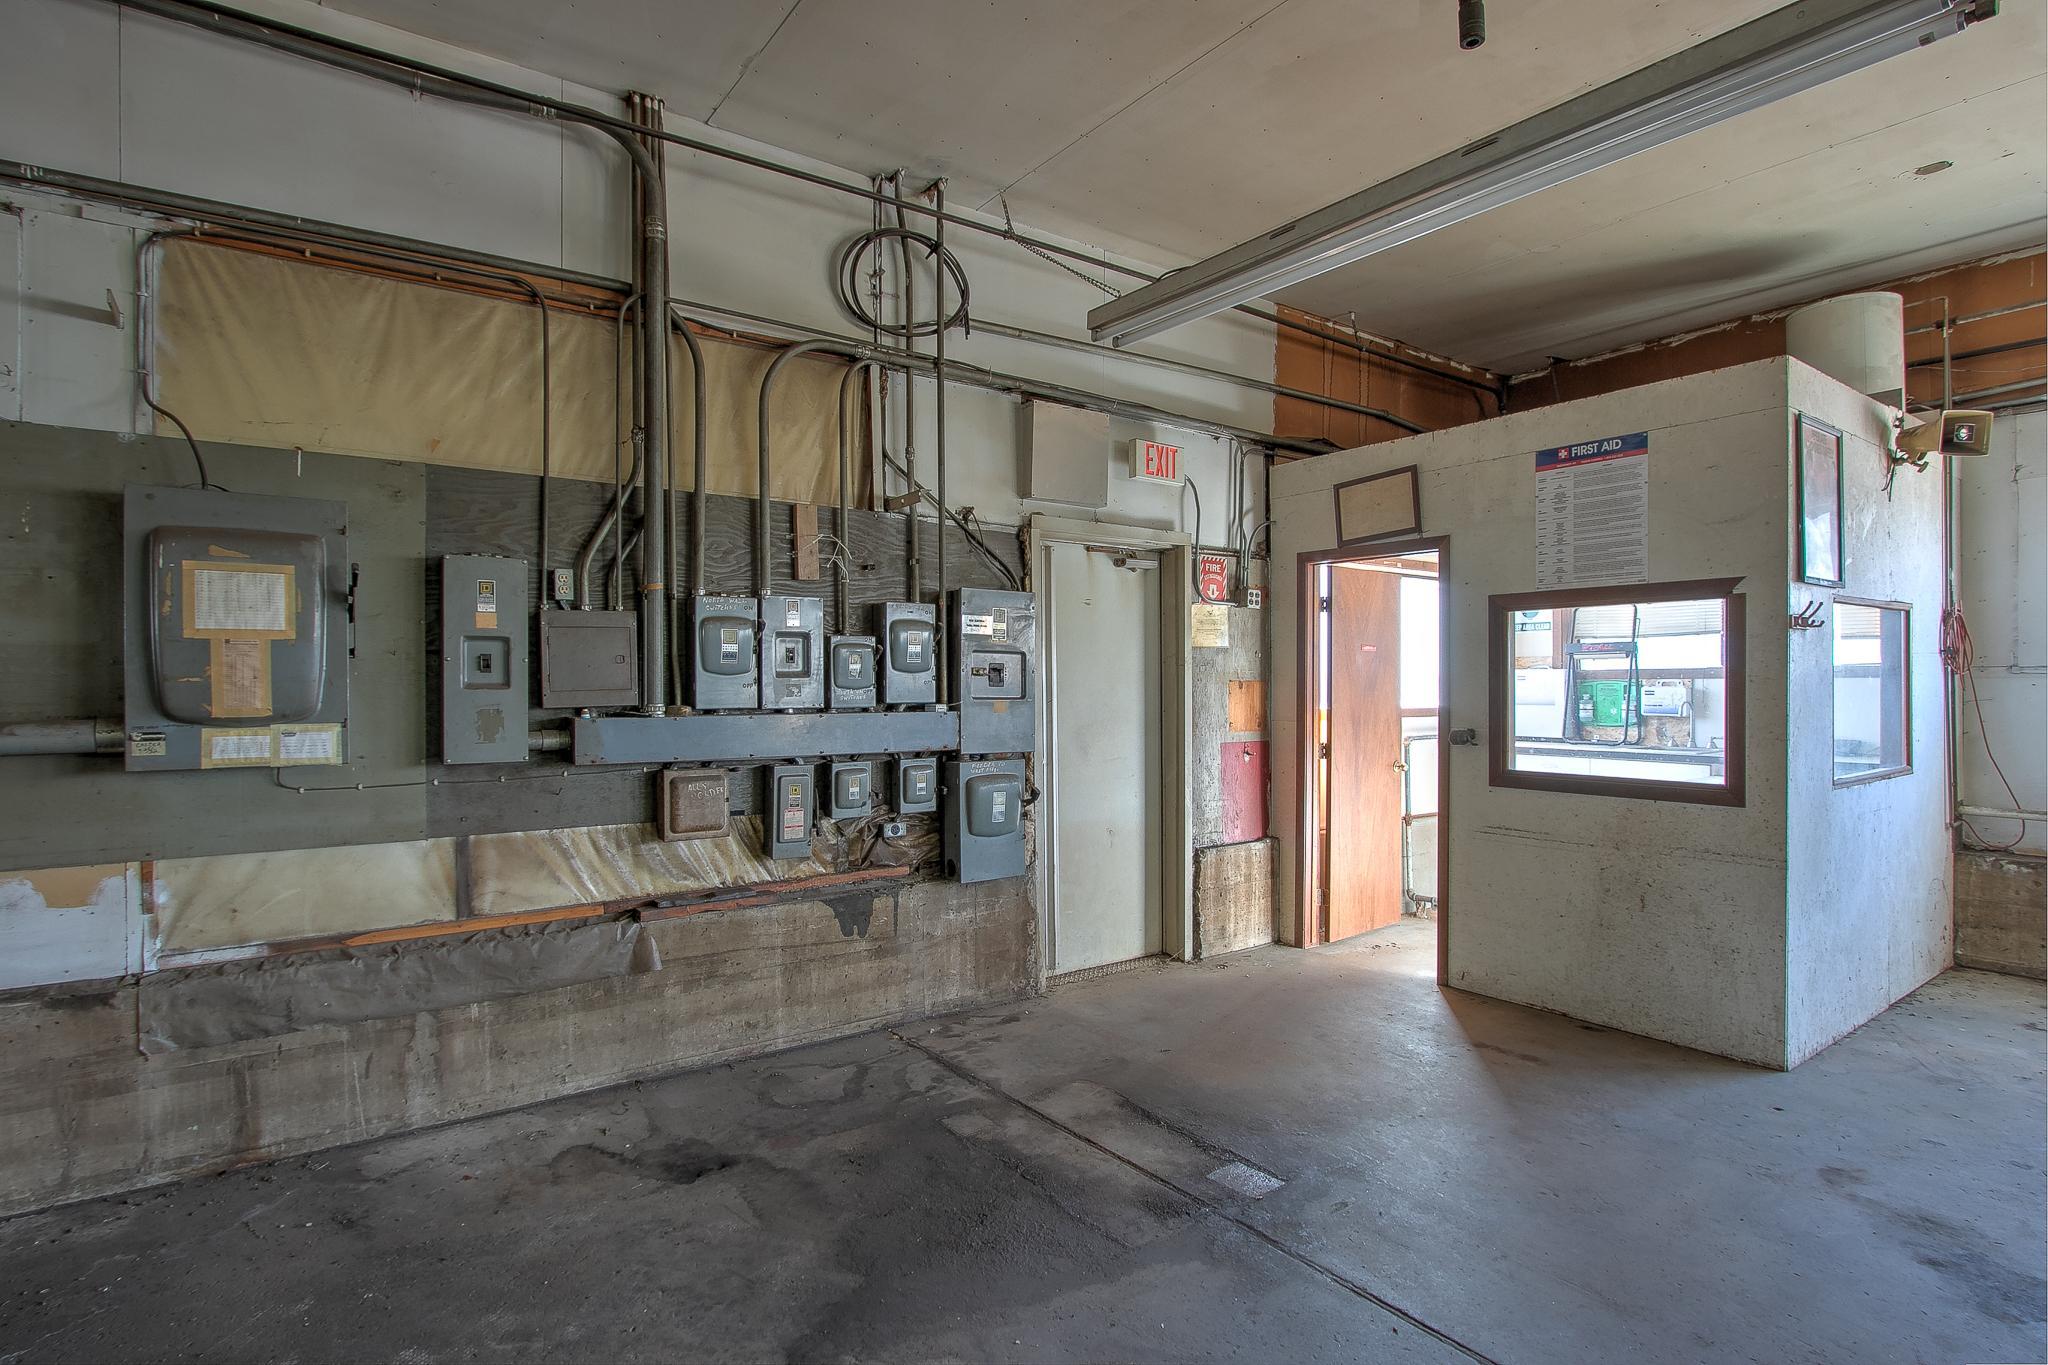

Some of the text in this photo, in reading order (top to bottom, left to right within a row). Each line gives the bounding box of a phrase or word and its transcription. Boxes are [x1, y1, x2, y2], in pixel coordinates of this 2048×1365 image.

[1571, 439, 1622, 458] FIRST AID
[1145, 442, 1178, 481] EXIT
[1205, 563, 1222, 573] FIRE
